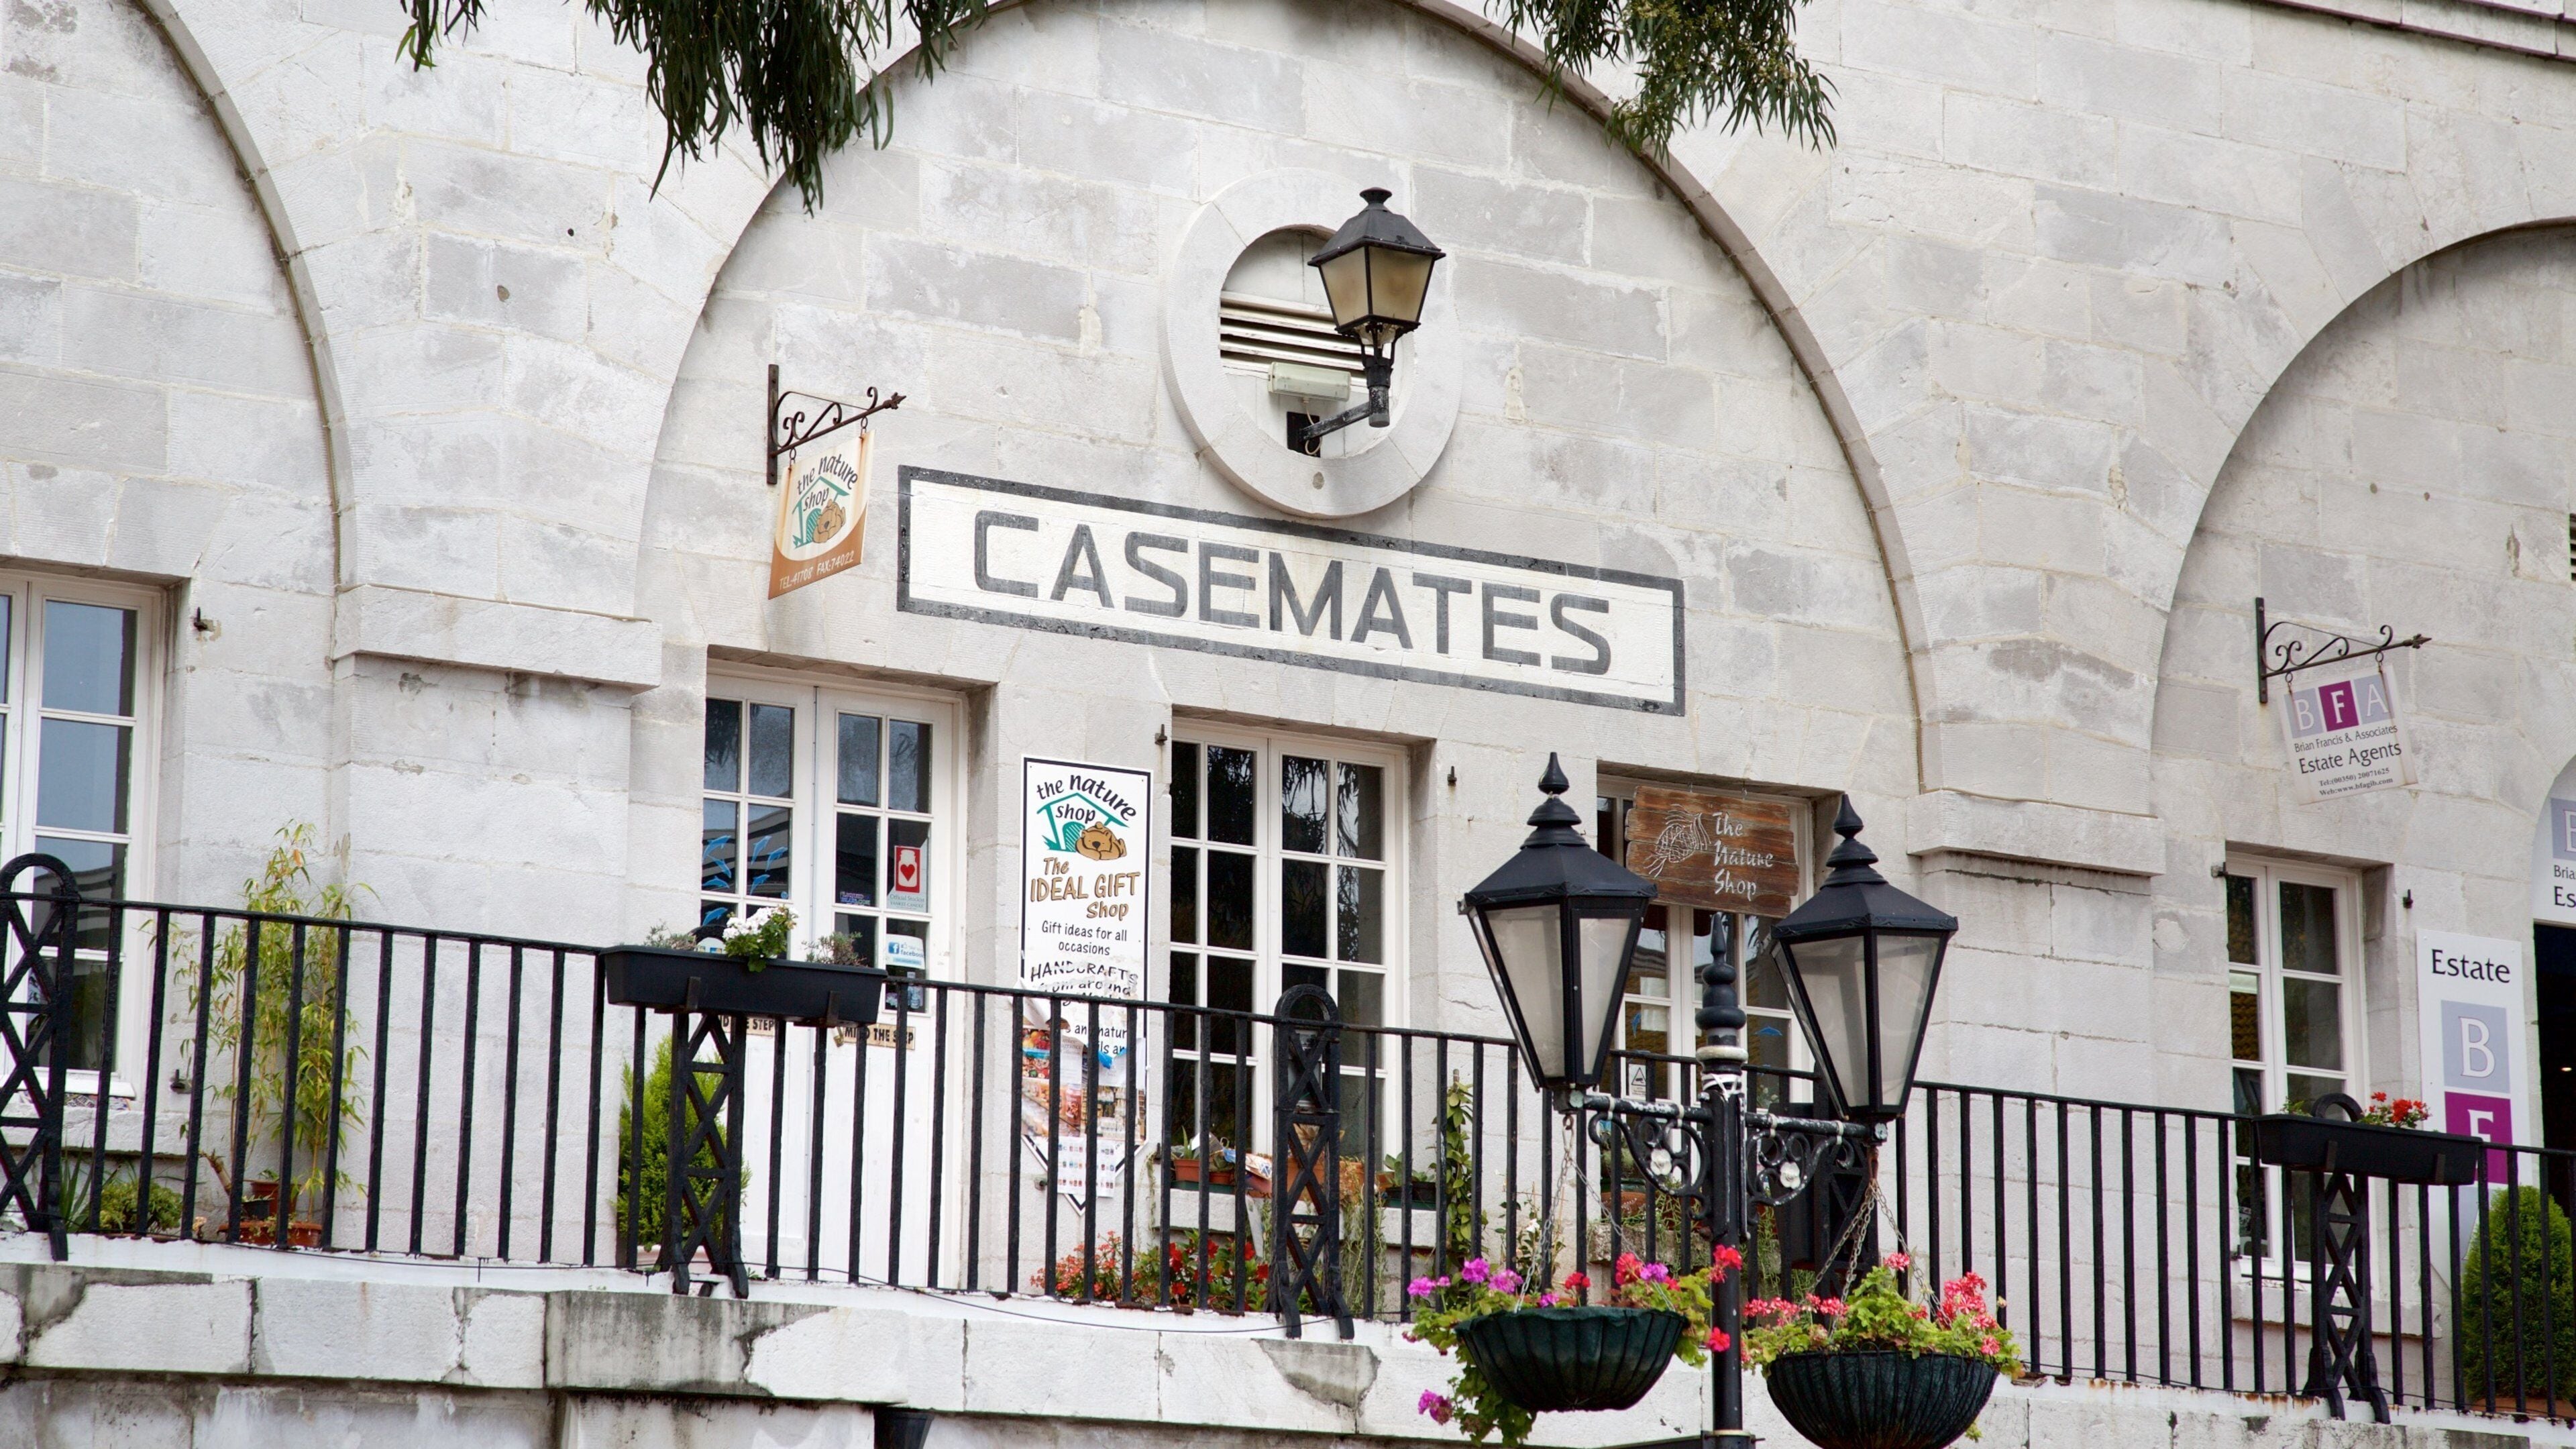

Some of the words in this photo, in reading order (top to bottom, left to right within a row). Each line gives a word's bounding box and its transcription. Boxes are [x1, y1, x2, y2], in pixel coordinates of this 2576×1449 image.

[797, 468, 814, 495] the
[818, 454, 858, 490] nature
[803, 488, 830, 511] shop
[974, 510, 1610, 674] CASEMATES
[2294, 741, 2314, 753] Brian
[2316, 735, 2343, 749] Francis
[2345, 733, 2353, 743] &
[2355, 725, 2398, 740] Associates
[2299, 754, 2343, 774] Estate
[2349, 742, 2402, 767] Agents
[1036, 780, 1064, 800] the
[1069, 775, 1136, 821] nature
[1055, 804, 1095, 824] shop
[1713, 812, 1743, 837] The
[1043, 857, 1069, 875] The
[1714, 839, 1773, 867] Nature
[1715, 868, 1756, 902] Shop
[2554, 865, 2576, 879] Bria
[1030, 875, 1089, 902] IDEAL
[1094, 871, 1140, 898] GIFT
[1086, 901, 1129, 921] Shop
[1042, 920, 1062, 934] Gift
[1065, 924, 1093, 938] ideas
[1096, 927, 1112, 940] for
[1115, 930, 1127, 941] all
[1059, 941, 1110, 955] occasions
[2432, 949, 2510, 983] Estate
[753, 1018, 774, 1031] STEP
[873, 1028, 890, 1041] THE
[2459, 1016, 2496, 1078] B
